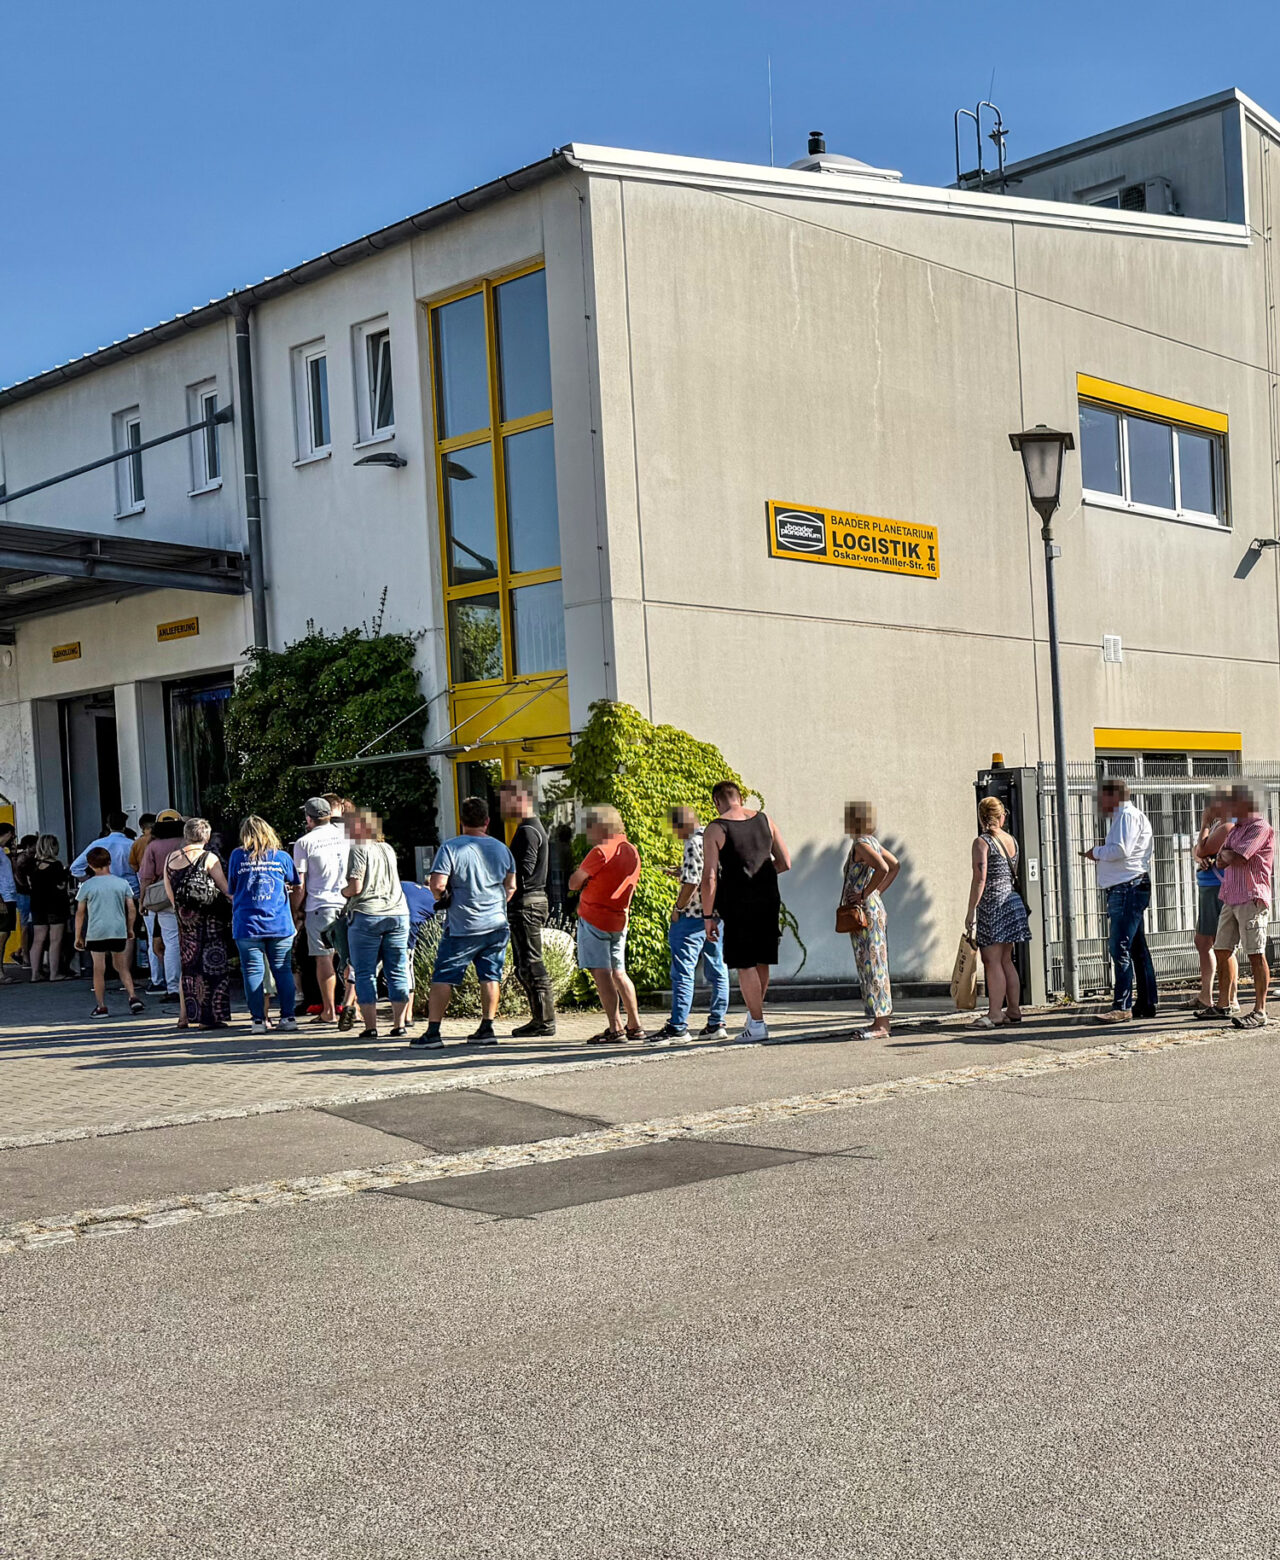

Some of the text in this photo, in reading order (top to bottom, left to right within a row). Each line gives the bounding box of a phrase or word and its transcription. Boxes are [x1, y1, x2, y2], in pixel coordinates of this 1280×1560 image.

[780, 526, 821, 539] planetarium
[785, 523, 814, 534] baader
[831, 515, 934, 540] BAADER PLANETARIUM
[832, 531, 936, 562] LOGISTIK I
[833, 549, 936, 571] Oskar-von-Miller-Str. 16
